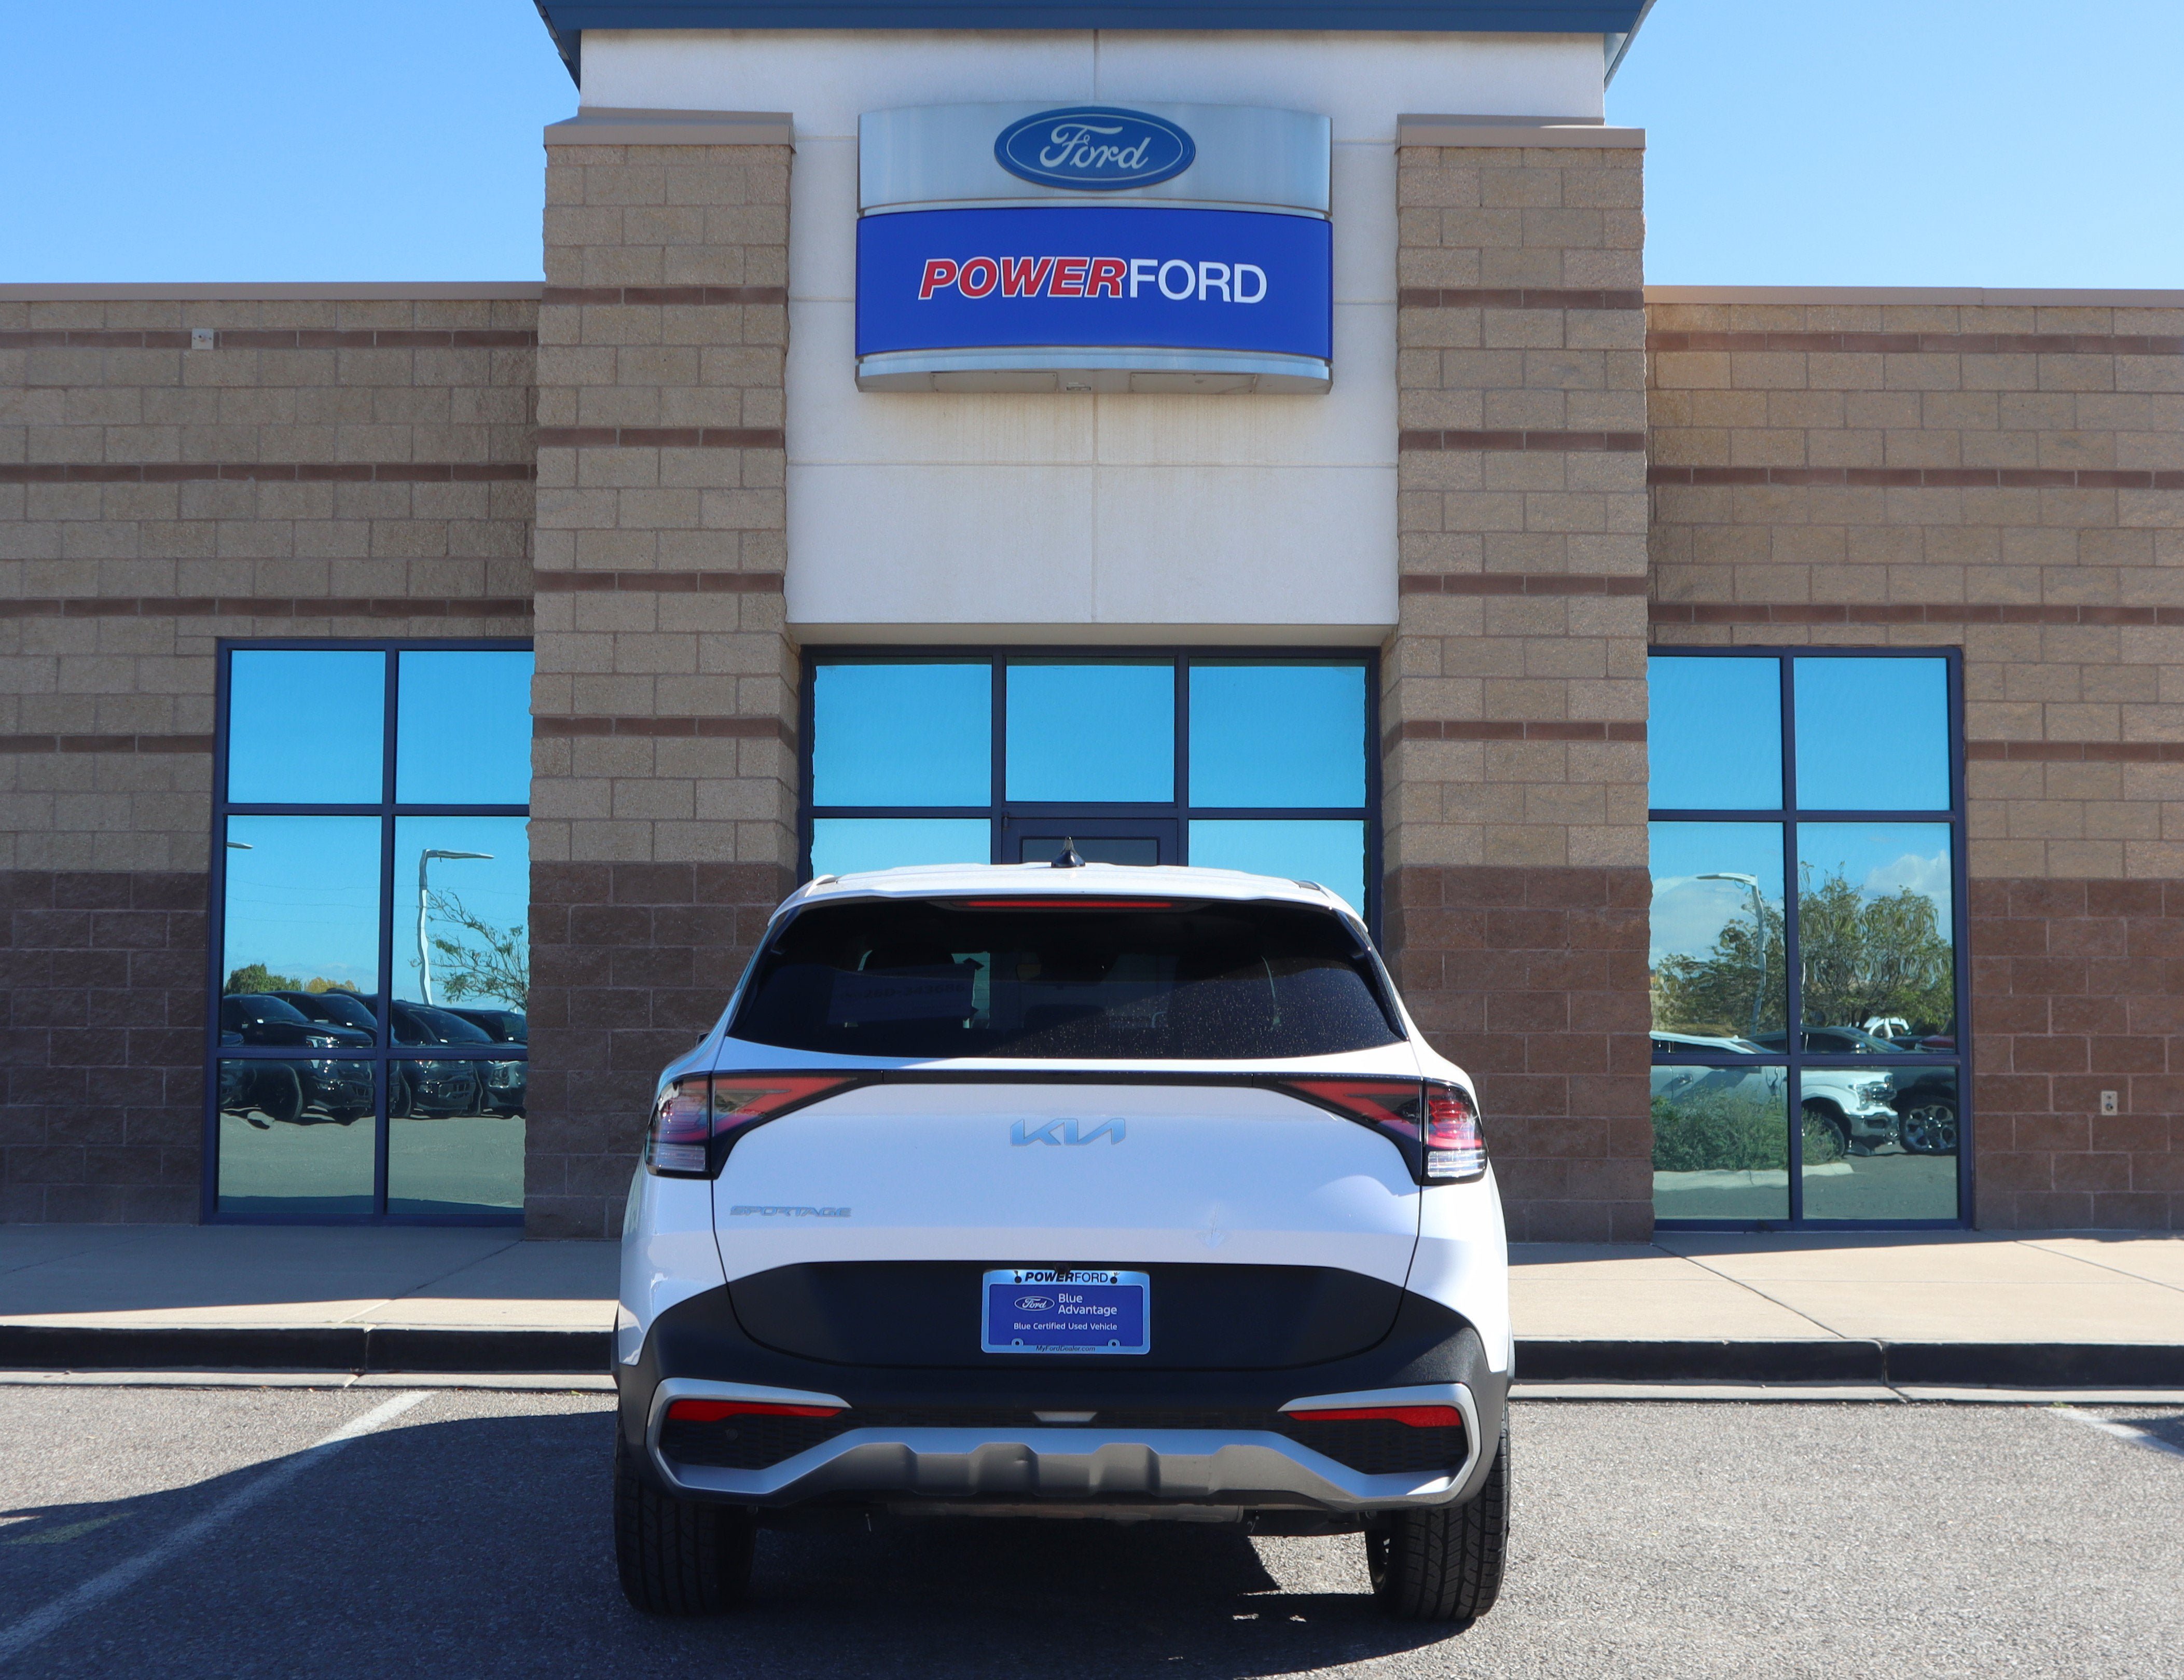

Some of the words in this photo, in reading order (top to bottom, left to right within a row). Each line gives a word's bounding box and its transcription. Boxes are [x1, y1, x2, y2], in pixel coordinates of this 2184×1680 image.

[1039, 123, 1151, 170] Ford
[1010, 1118, 1125, 1146] KIA
[730, 1205, 851, 1218] SPORTAGE
[1022, 1298, 1047, 1309] Ford
[1058, 1293, 1083, 1303] Blue
[1058, 1304, 1117, 1317] Advantage
